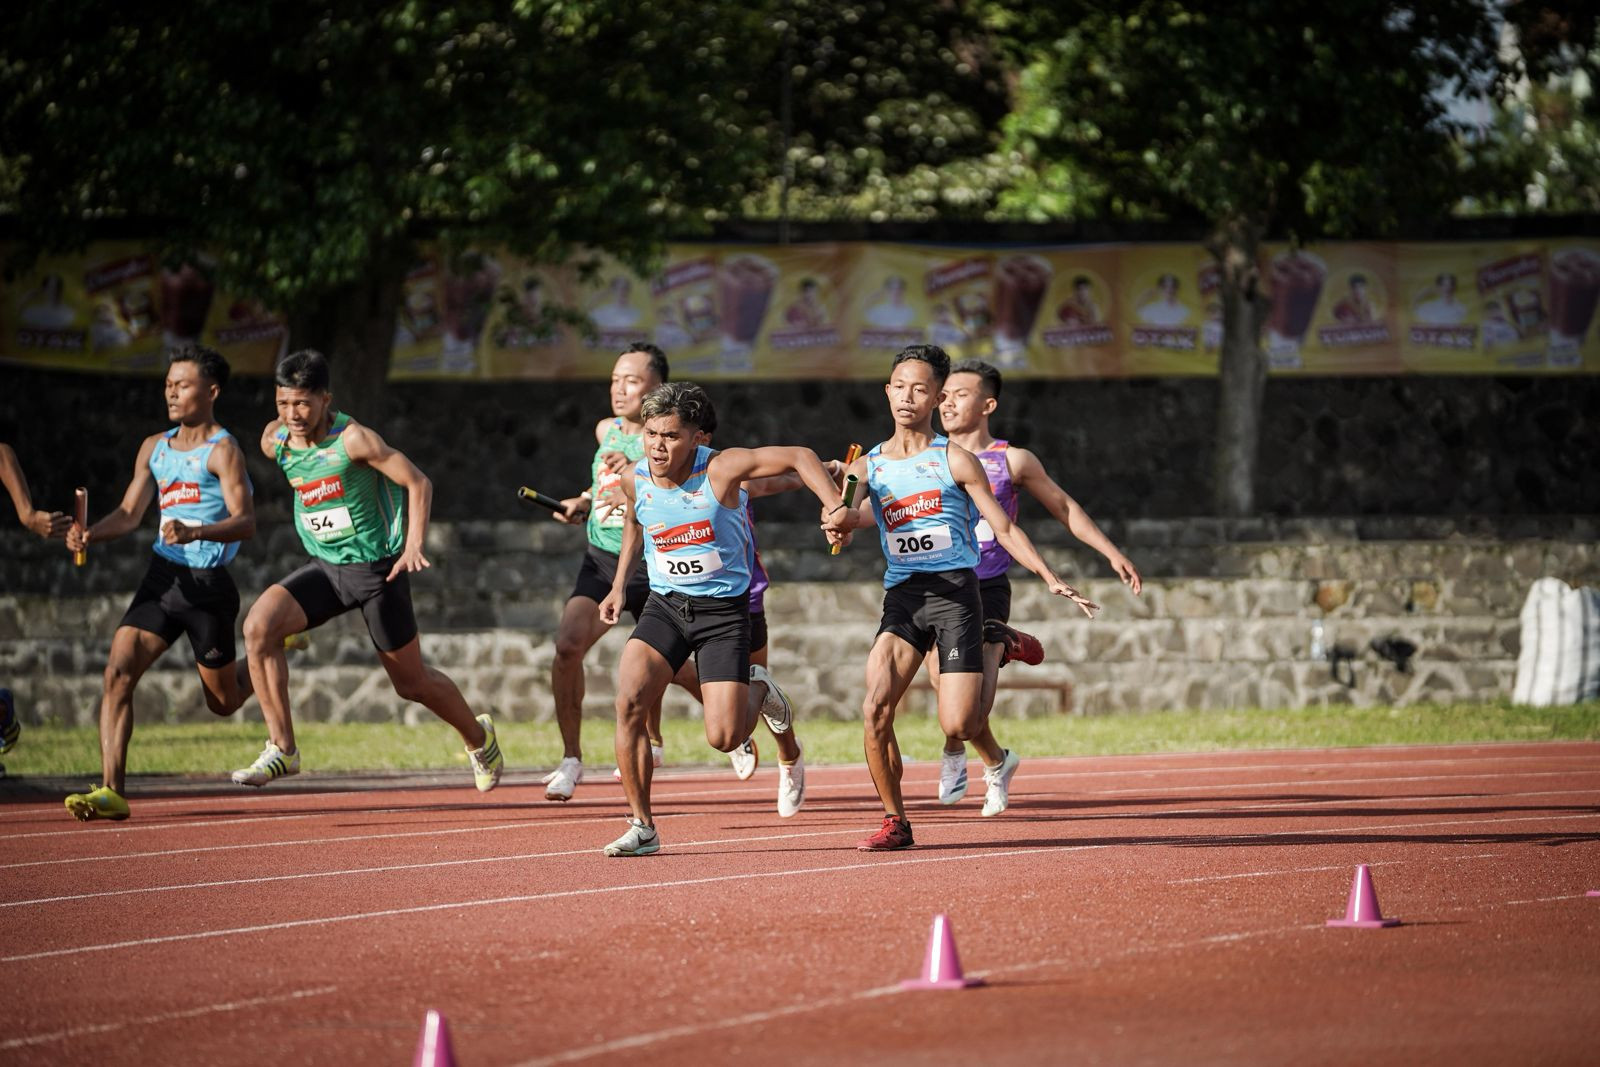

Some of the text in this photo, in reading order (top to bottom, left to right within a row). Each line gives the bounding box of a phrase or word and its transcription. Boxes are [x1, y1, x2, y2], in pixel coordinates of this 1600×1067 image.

[885, 495, 940, 525] Champion
[896, 535, 934, 553] 206
[667, 560, 704, 575] 205
